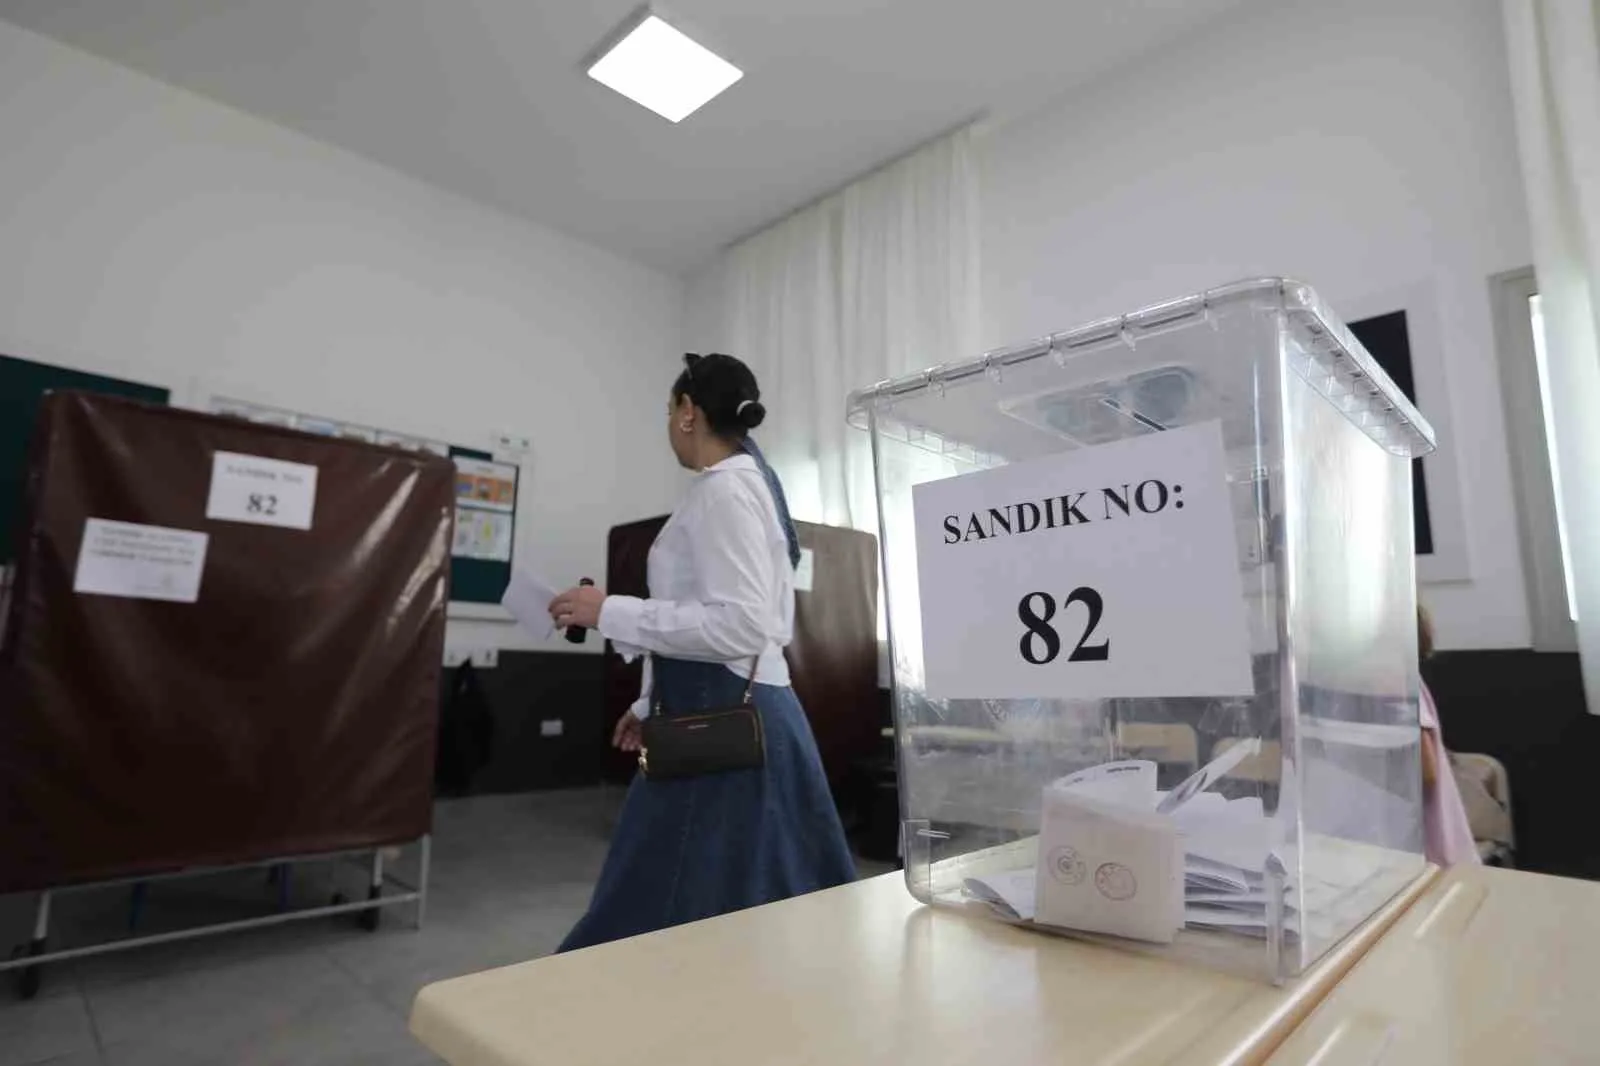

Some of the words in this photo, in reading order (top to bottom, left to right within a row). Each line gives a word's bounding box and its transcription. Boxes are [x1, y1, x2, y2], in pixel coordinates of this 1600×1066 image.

[246, 492, 278, 516] 82
[943, 491, 1091, 545] SANDIK
[1101, 479, 1184, 520] NO:
[1017, 586, 1110, 665] 82
